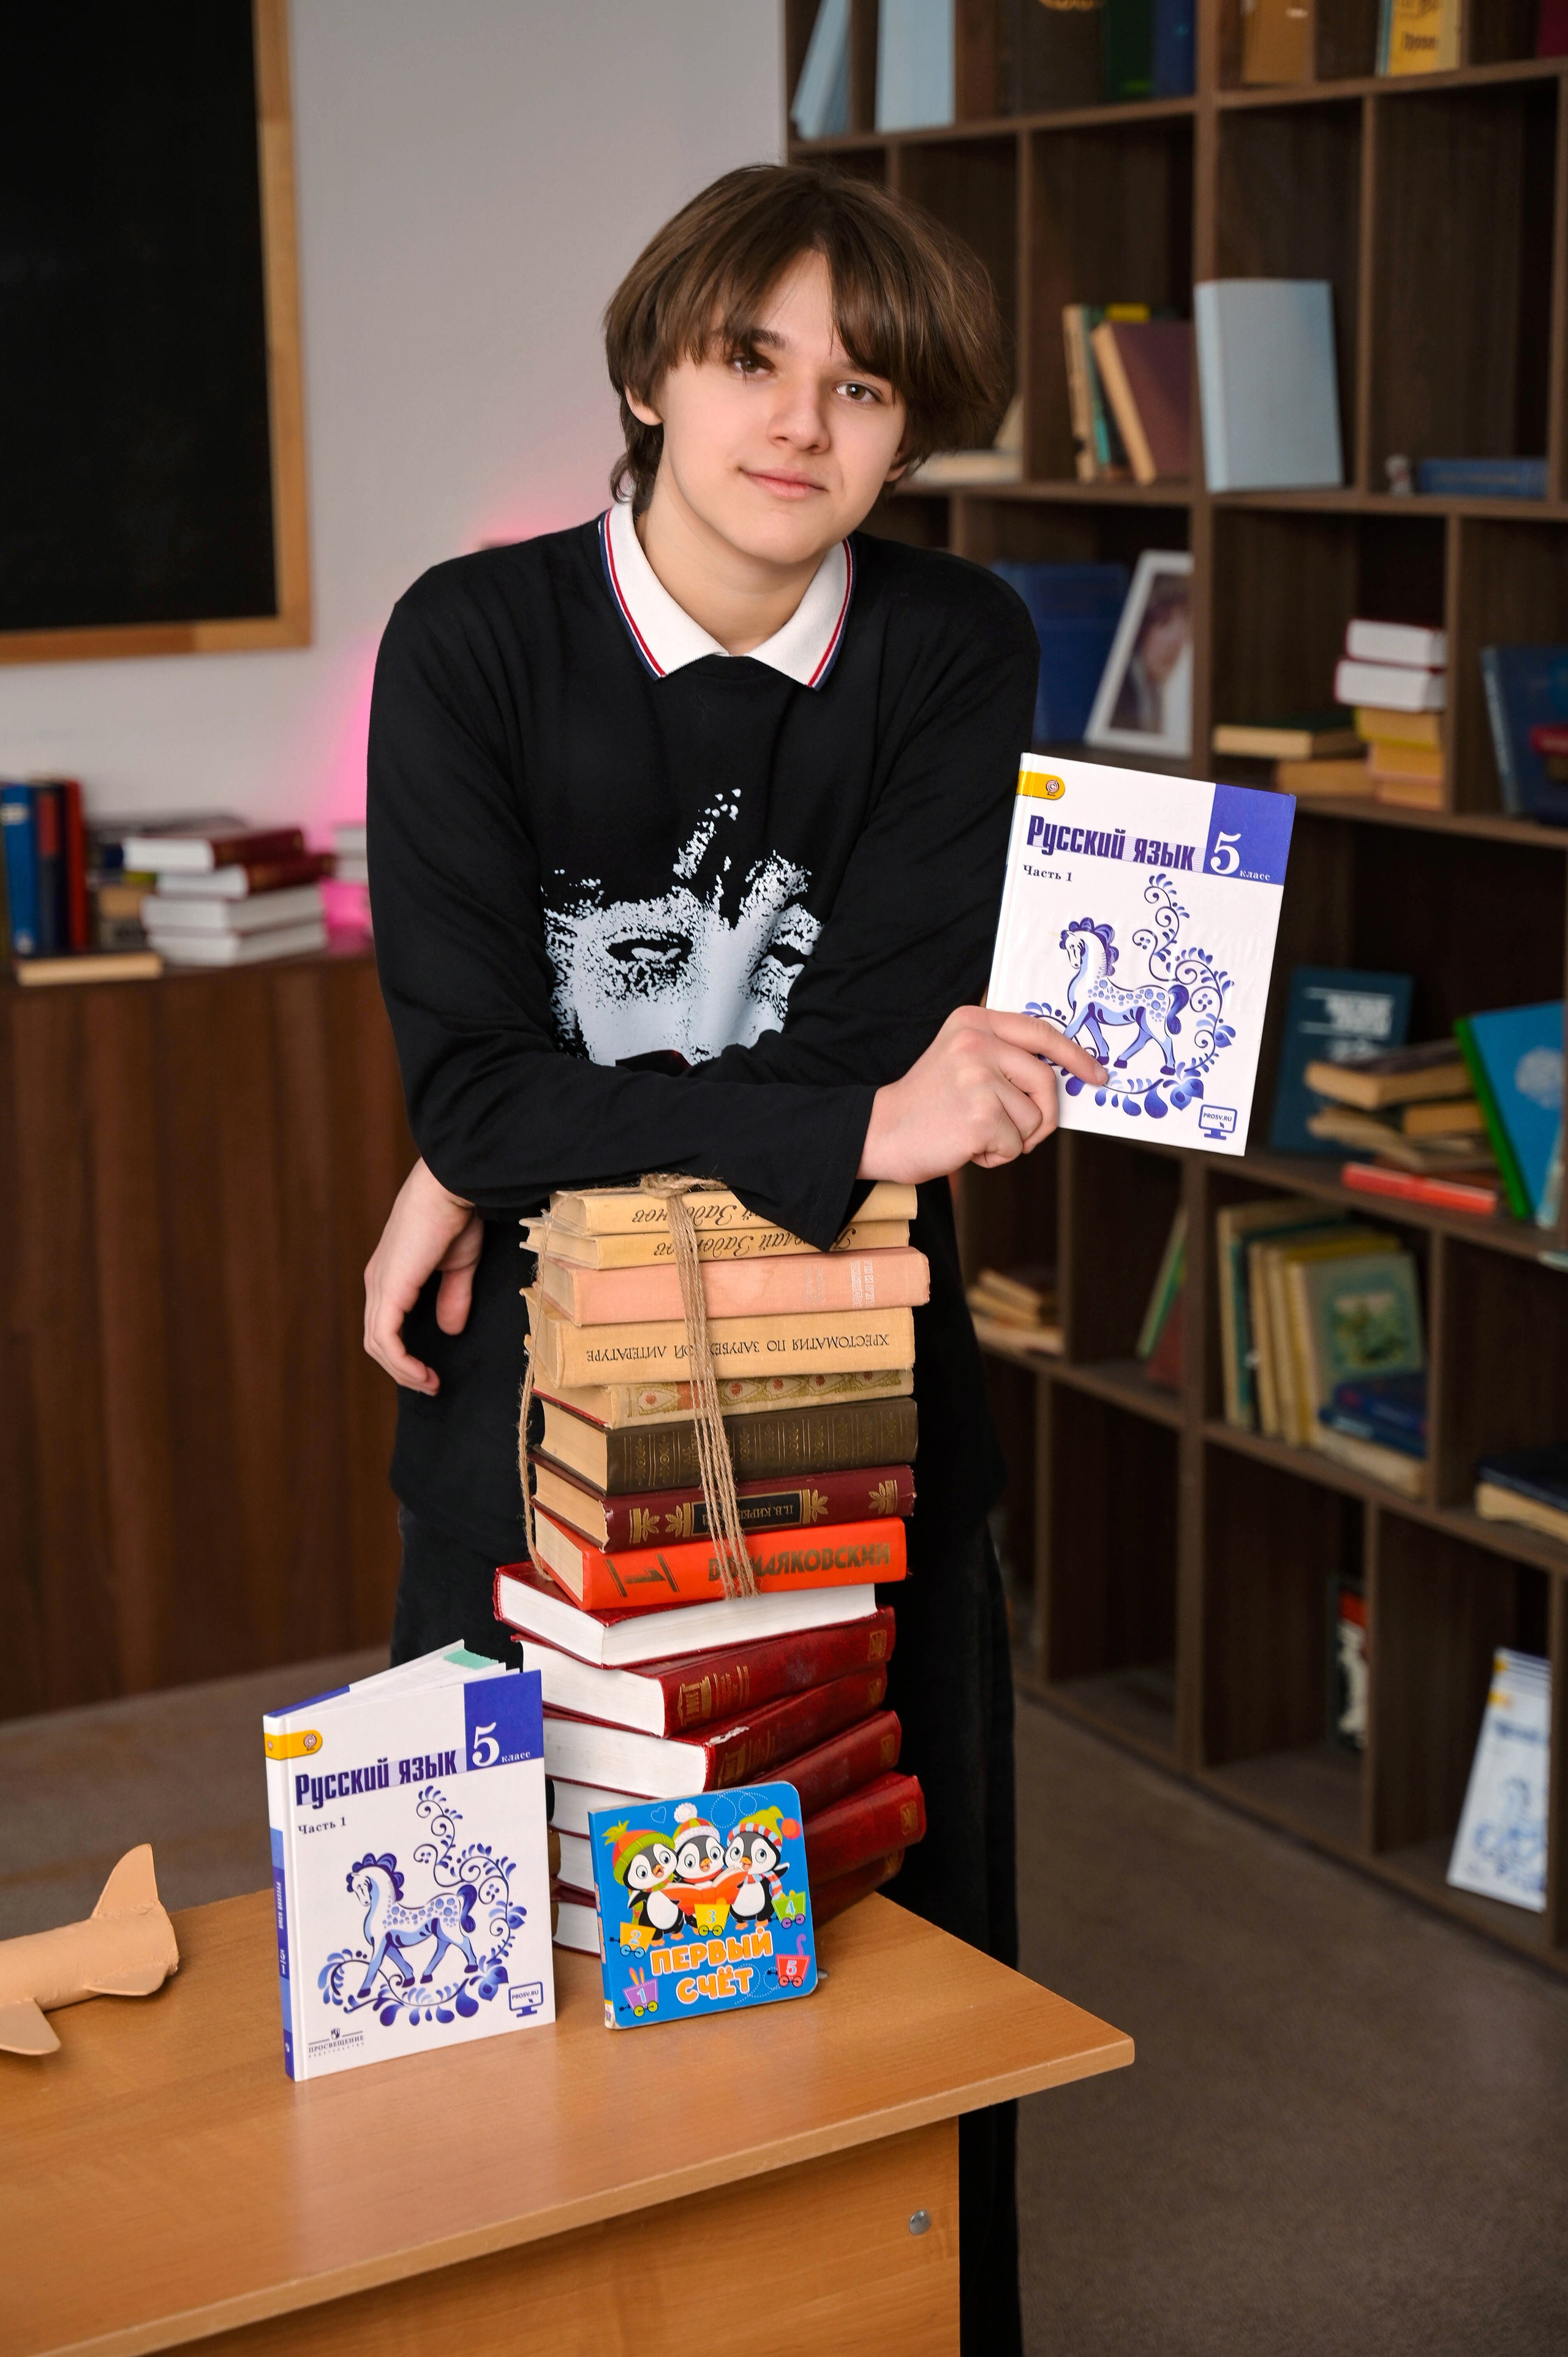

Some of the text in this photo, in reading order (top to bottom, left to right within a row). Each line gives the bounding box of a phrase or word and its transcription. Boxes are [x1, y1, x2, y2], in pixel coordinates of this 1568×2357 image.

[1027, 815, 1195, 871] Русский язык
[1210, 831, 1271, 881] 5 класс
[1023, 864, 1072, 882] Часть 1
[1203, 1112, 1232, 1122] PROSV.RU
[632, 1204, 737, 1226] Задонов
[654, 1235, 753, 1258] Задоов
[586, 1333, 890, 1362] ХРЕСТОМАТИЯ ПО ЗАРУБЕОЙ ЛИТЕРАТУРЕ
[472, 1721, 532, 1769] 5 класс
[295, 1750, 458, 1811] Русский язык
[298, 1816, 347, 1836] Часть 1
[706, 1909, 717, 1924] 3
[785, 1901, 796, 1916] 4
[629, 1930, 641, 1944] 2
[650, 1926, 774, 1976] ПЕРВЫЙ
[786, 1960, 797, 1974] 5
[511, 1989, 539, 2000] PROSV.RU
[637, 1988, 646, 2003] 1
[675, 1967, 755, 2005] СЧЁТ
[309, 2035, 364, 2054] ПРОСВЕЩЕНИЕ
